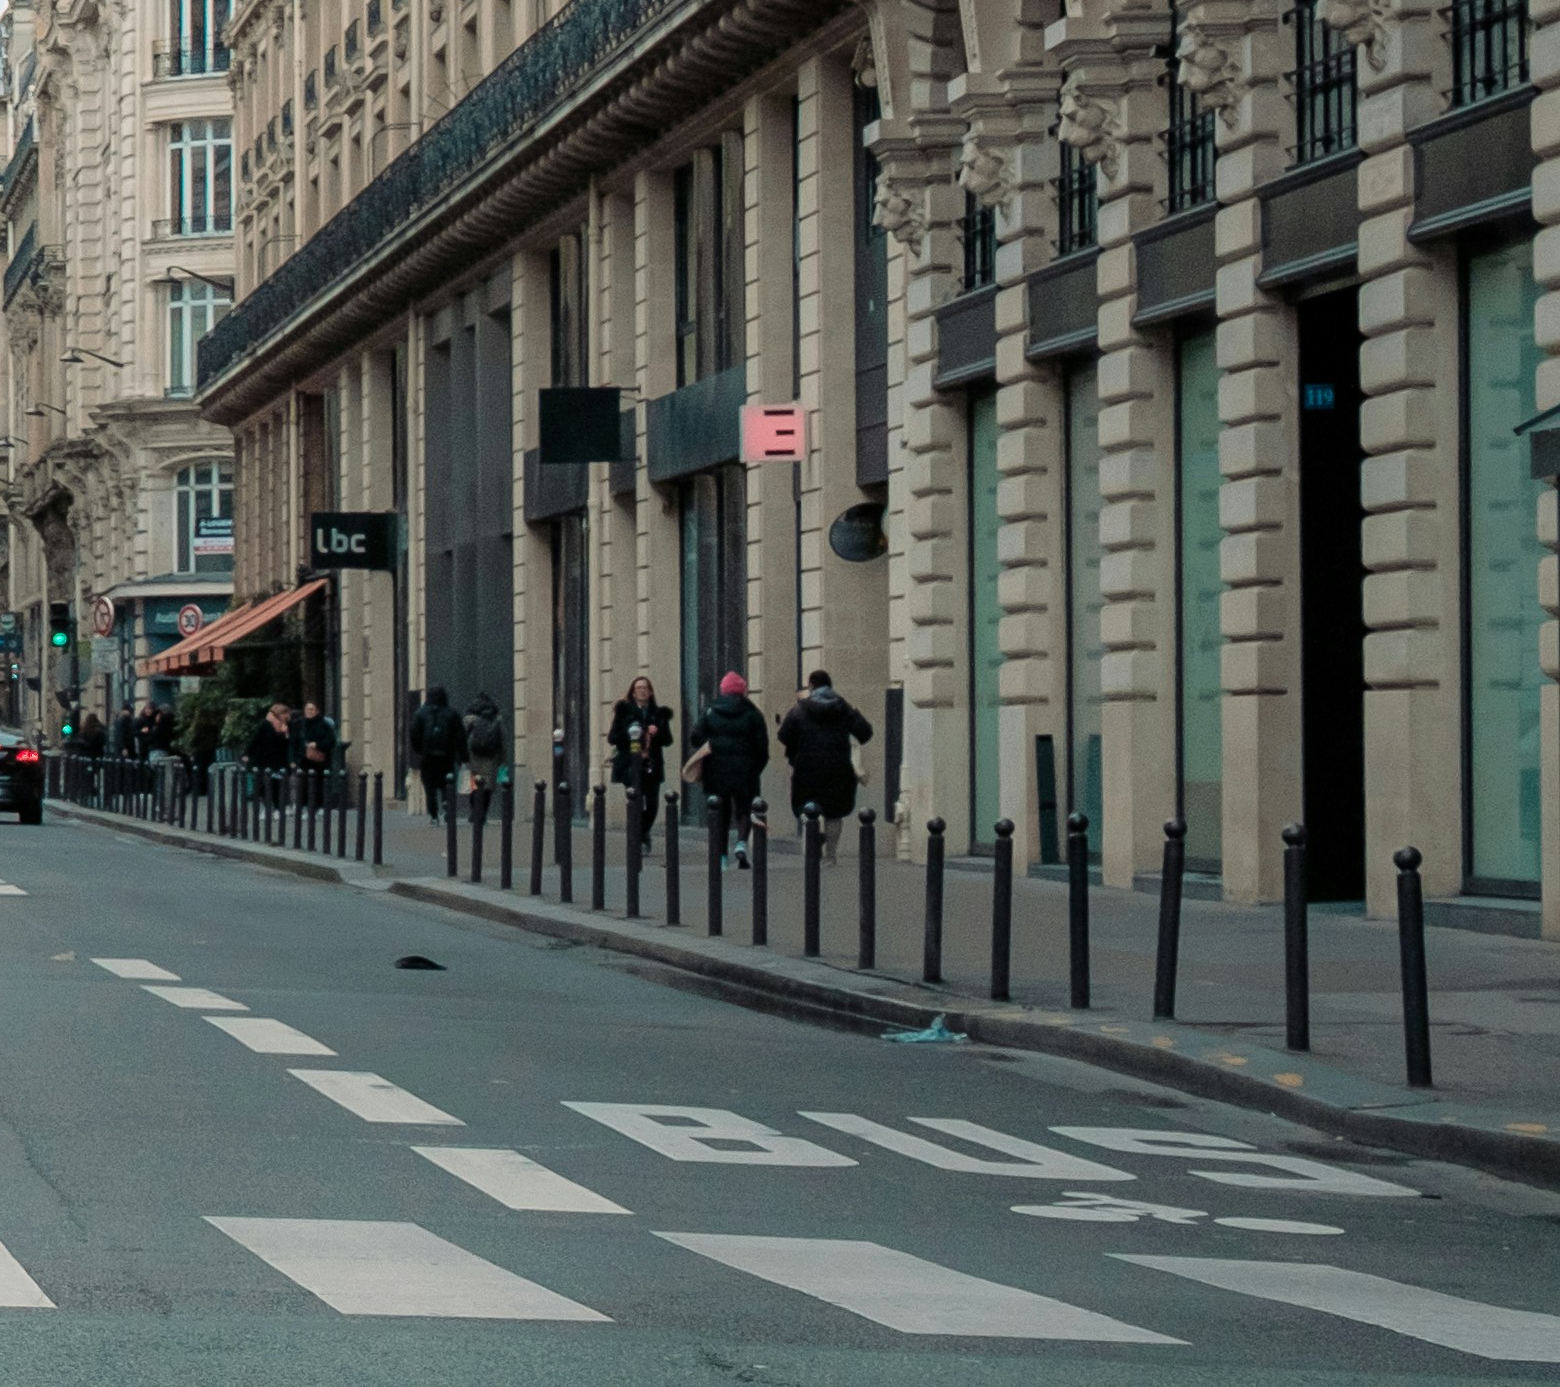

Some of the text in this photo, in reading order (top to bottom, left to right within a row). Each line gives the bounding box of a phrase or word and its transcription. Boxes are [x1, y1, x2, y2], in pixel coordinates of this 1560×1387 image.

[1307, 389, 1333, 405] 119
[316, 527, 367, 553] lbc
[559, 1099, 1422, 1197] BUS
